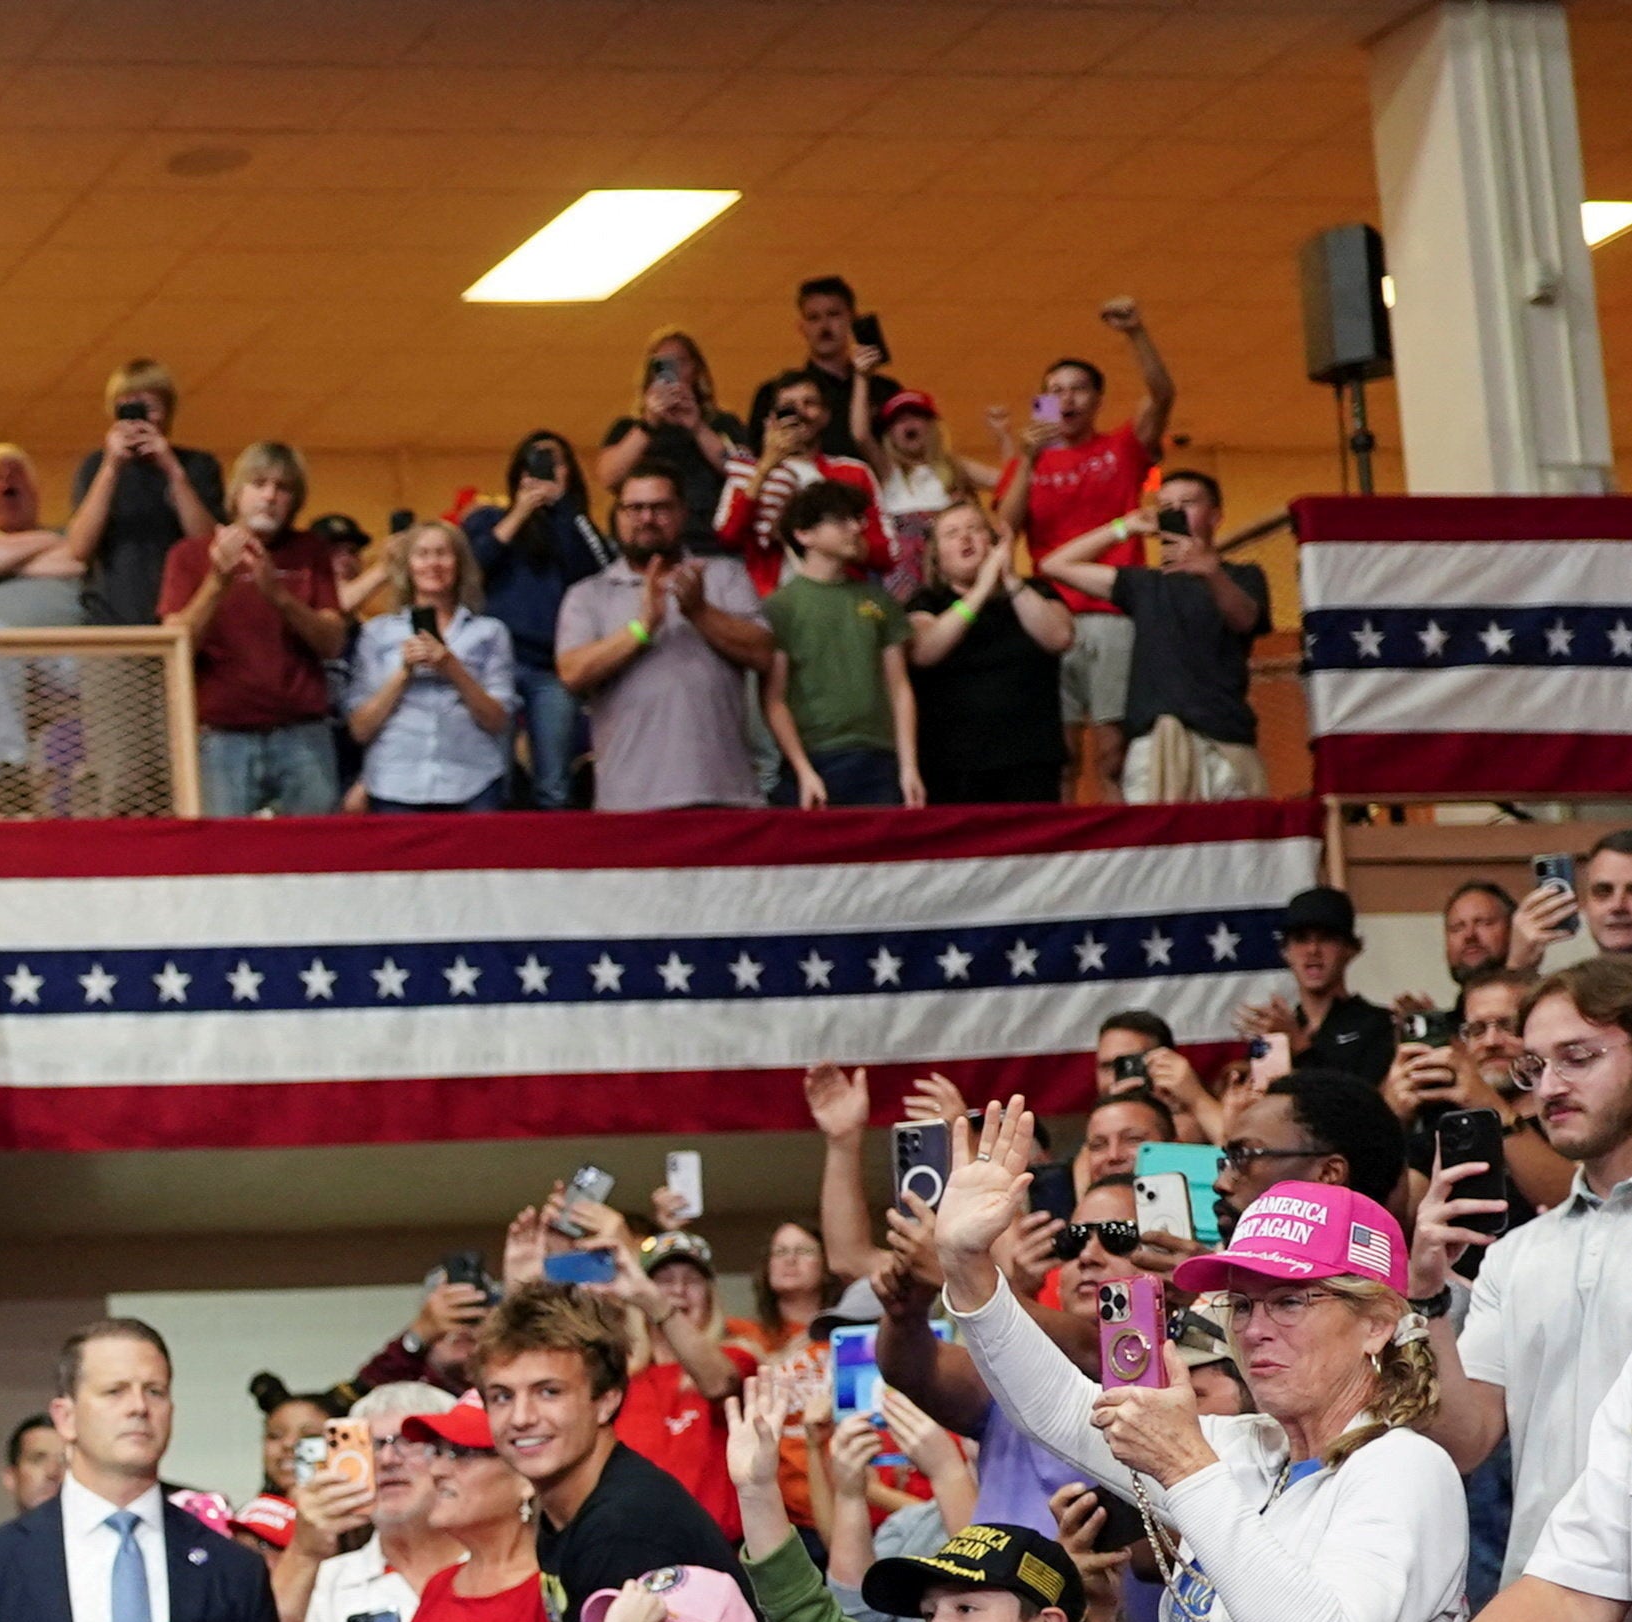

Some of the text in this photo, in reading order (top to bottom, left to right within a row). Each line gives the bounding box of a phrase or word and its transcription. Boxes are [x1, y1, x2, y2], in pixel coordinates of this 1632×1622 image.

[1257, 1196, 1329, 1226] AMERICA
[1255, 1217, 1315, 1246] AGAIN
[940, 1539, 992, 1561] AGAIN
